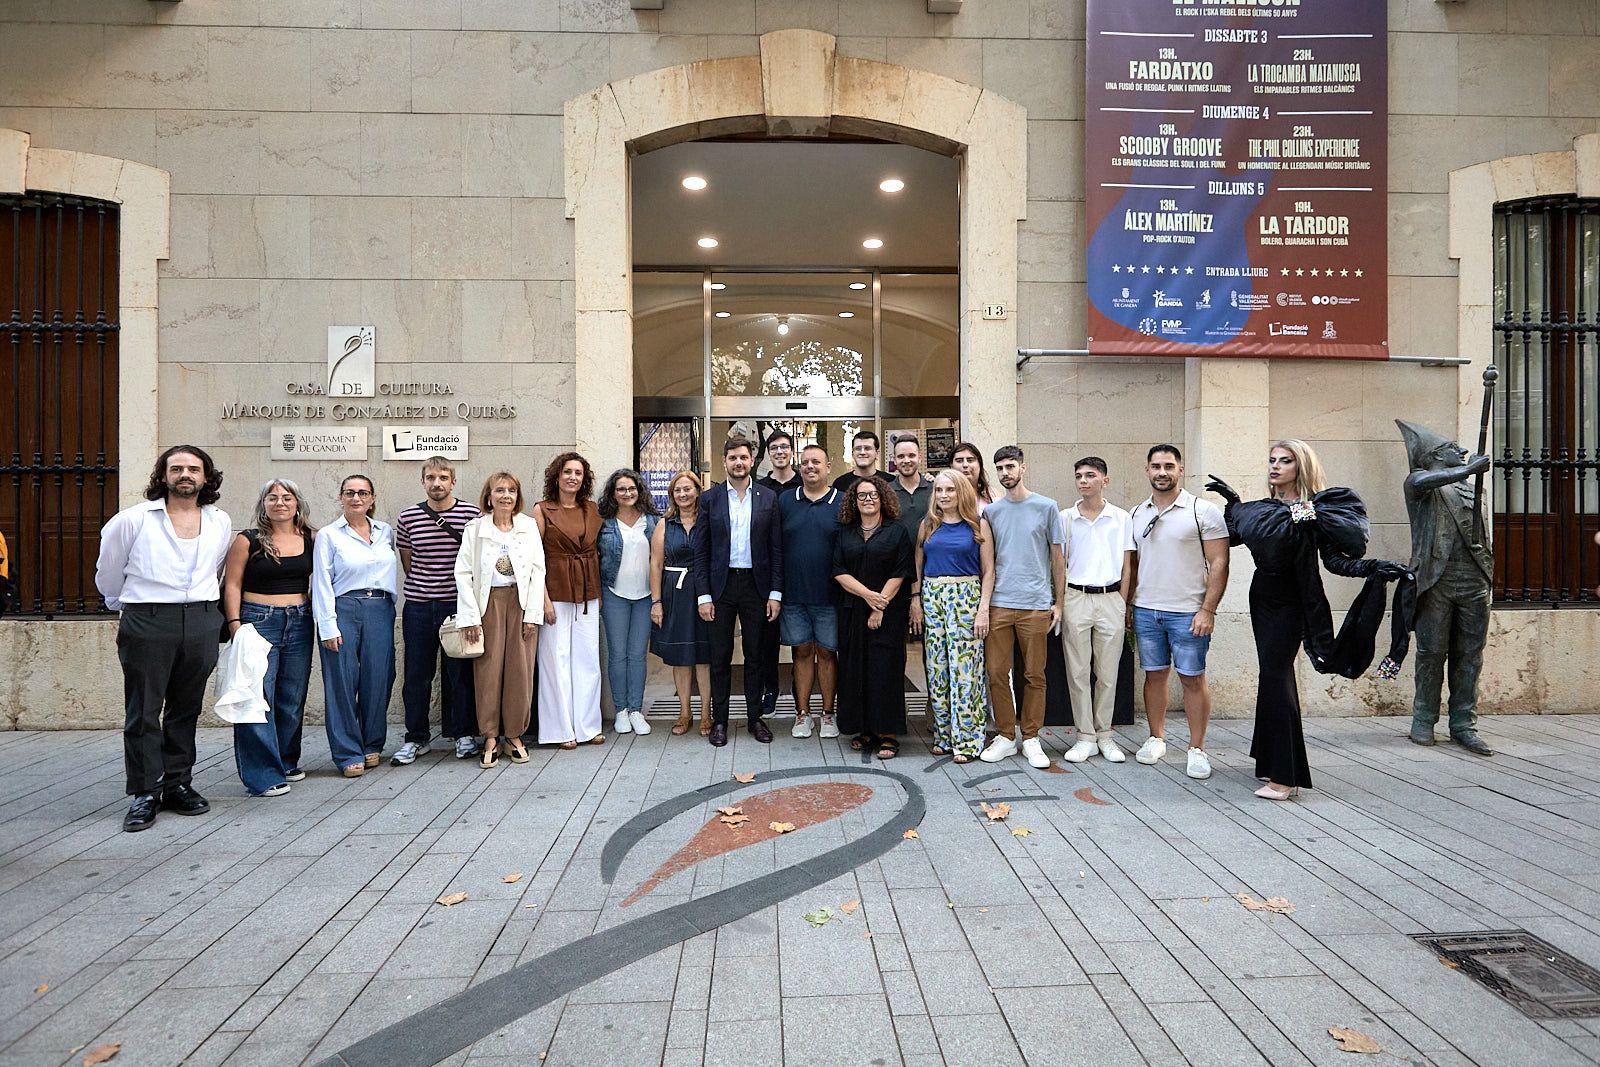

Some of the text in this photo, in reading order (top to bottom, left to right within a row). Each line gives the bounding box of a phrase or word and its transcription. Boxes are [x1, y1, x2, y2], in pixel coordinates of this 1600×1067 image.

[1176, 8, 1182, 16] EL
[1183, 8, 1198, 16] ROCK
[1203, 8, 1218, 16] L'SKA
[1220, 8, 1237, 16] REBEL
[1238, 8, 1251, 17] DELS
[1252, 8, 1272, 18] ÚLTIMS
[1273, 9, 1281, 18] 50
[1282, 9, 1298, 18] ANYS
[1204, 29, 1268, 43] DISSABTE 3
[1158, 48, 1177, 60] 13H.
[1294, 50, 1314, 60] 23H.
[1129, 61, 1214, 80] FARDATXO
[1248, 64, 1360, 82] LA TROCAMBA MATANUSCA
[1118, 82, 1134, 90] FUSIÓ
[1210, 84, 1231, 93] LLATINS
[1254, 85, 1264, 94] ELS
[1264, 86, 1300, 94] IMPARABLES
[1301, 86, 1322, 94] RITMES
[1202, 105, 1270, 120] DIUMENGE 4
[1159, 124, 1178, 136] 13H.
[1293, 126, 1314, 137] 23H.
[1120, 136, 1222, 157] SCOOBY GROOVE
[1248, 139, 1360, 158] THE PHIL COLLINS EXPERIENCE
[1112, 158, 1121, 166] ELS
[1122, 158, 1141, 167] GRANS
[1170, 160, 1180, 168] DEL
[1181, 160, 1194, 168] SOUL
[1247, 162, 1280, 170] HOMENATGE
[1282, 162, 1289, 170] AL
[1290, 162, 1324, 170] LLEGENDARI
[1324, 160, 1344, 170] MÚSIC
[1208, 181, 1264, 196] DILLUNS 5
[1160, 200, 1178, 211] 13H.
[1294, 202, 1314, 213] 19H.
[1124, 209, 1214, 232] ÁLEX MARTÍNEZ
[1260, 216, 1349, 235] LA TARDOR
[1142, 235, 1172, 243] POP-ROCK
[1260, 237, 1284, 246] BOLERO,
[1284, 238, 1316, 246] GUARACHA
[1320, 238, 1332, 246] SON
[1206, 266, 1268, 278] ENTRADA LLIURE
[286, 382, 454, 396] CASA DE CULTURA
[222, 402, 300, 420] MARQUÉS
[304, 406, 326, 418] DE
[332, 404, 424, 420] GONZÁLEZ
[428, 406, 449, 418] DE
[300, 435, 356, 443] AJUNTAMENT
[416, 434, 460, 443] Fundació
